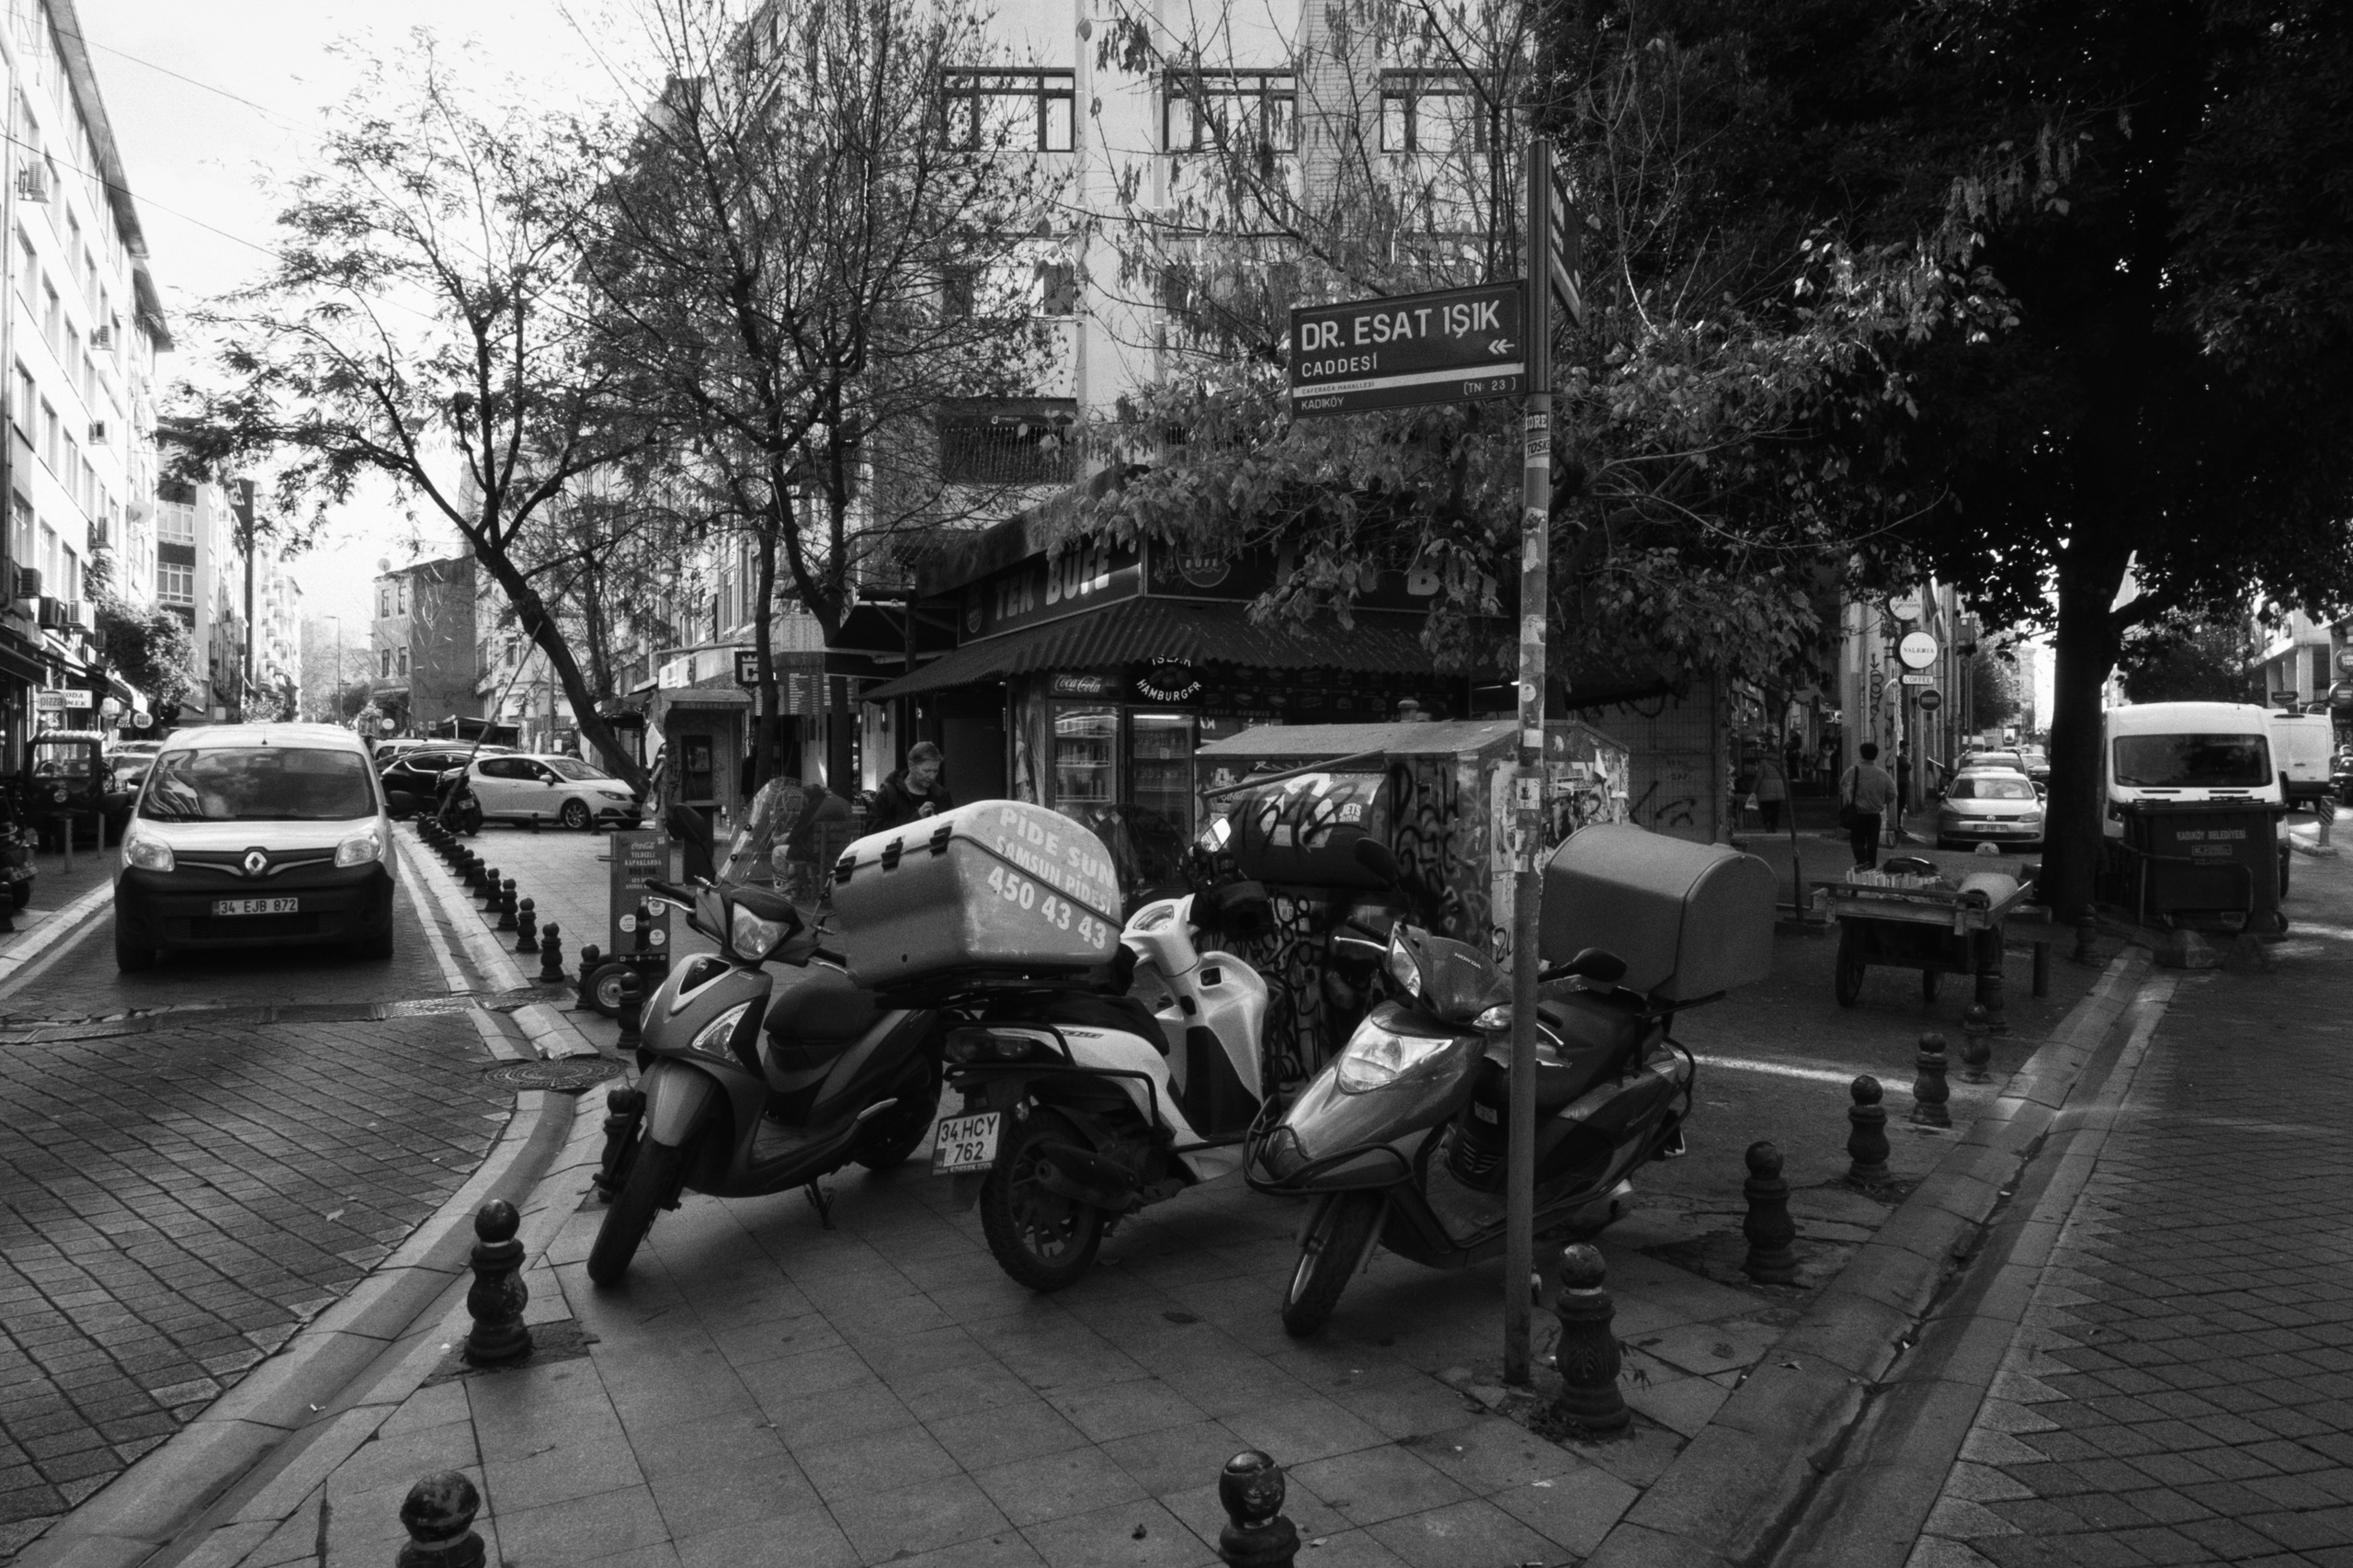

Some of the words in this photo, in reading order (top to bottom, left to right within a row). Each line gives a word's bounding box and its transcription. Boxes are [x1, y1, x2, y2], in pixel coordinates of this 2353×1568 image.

[1302, 321, 1346, 351] DR.
[1354, 308, 1433, 346] ESAT
[1443, 300, 1500, 339] IŞIK
[1302, 352, 1377, 378] CADDESİ
[1302, 395, 1344, 410] KADIKÖY
[995, 568, 1035, 621] TEK
[40, 696, 63, 708] pizza
[1136, 678, 1202, 701] HAMBURGER
[999, 807, 1060, 857] PİDE
[1066, 846, 1115, 889] SUN
[995, 835, 1061, 887] SAMSUN
[1065, 875, 1113, 915] PİDESİ
[221, 902, 235, 914] 34
[244, 901, 267, 913] EJB
[274, 899, 297, 912] 872
[987, 866, 1035, 910] 450
[1040, 894, 1072, 931] 43
[1077, 915, 1108, 950] 43
[1454, 952, 1482, 970] HONDA
[940, 1121, 959, 1142] 34
[961, 1114, 998, 1140] HCY
[953, 1141, 984, 1164] 762
